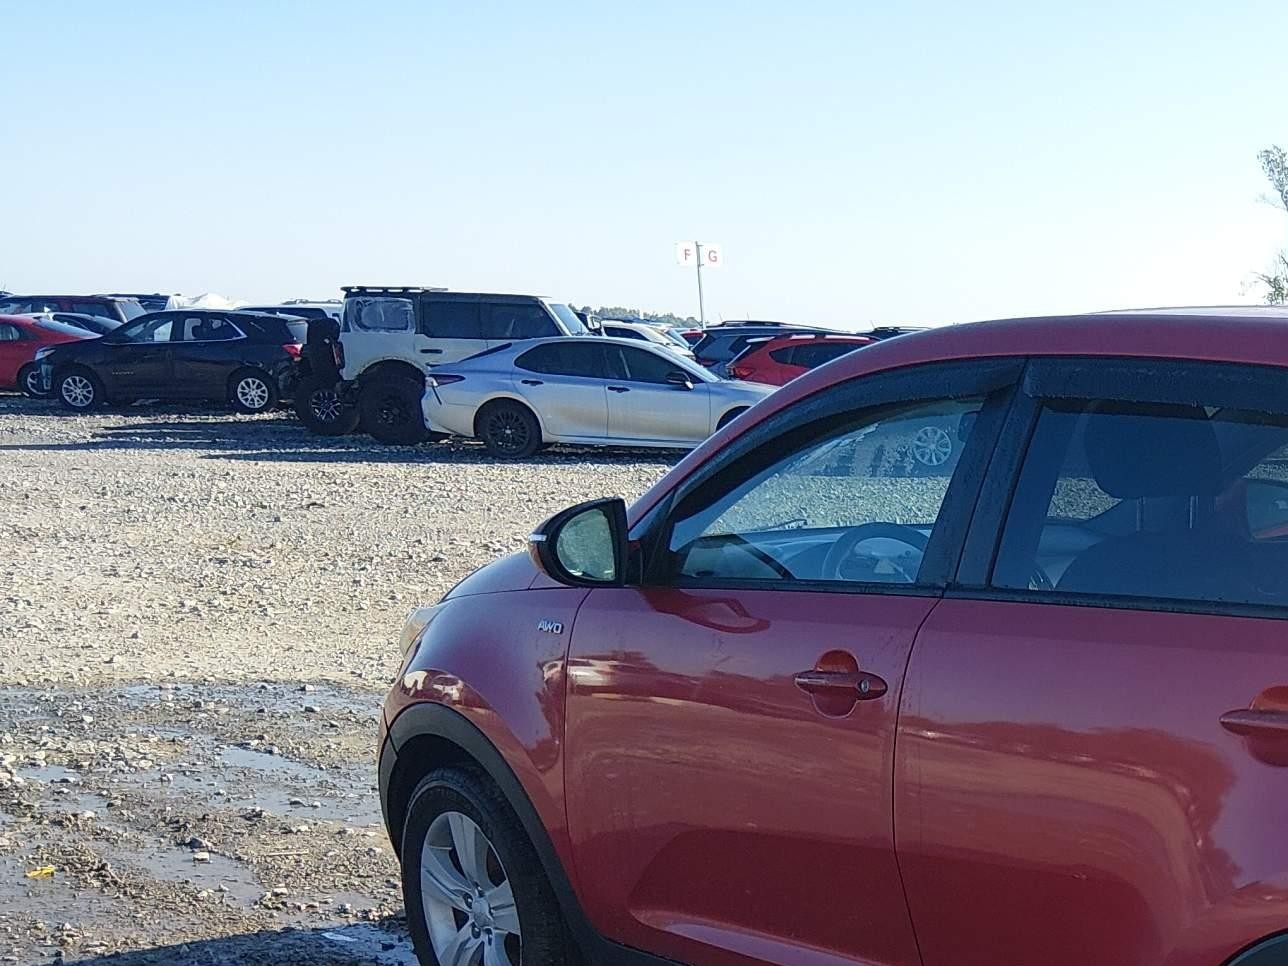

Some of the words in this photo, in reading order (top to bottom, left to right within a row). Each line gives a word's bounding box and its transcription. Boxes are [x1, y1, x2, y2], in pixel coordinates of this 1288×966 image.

[684, 248, 691, 261] F
[707, 249, 718, 263] G
[537, 620, 563, 634] AWD
